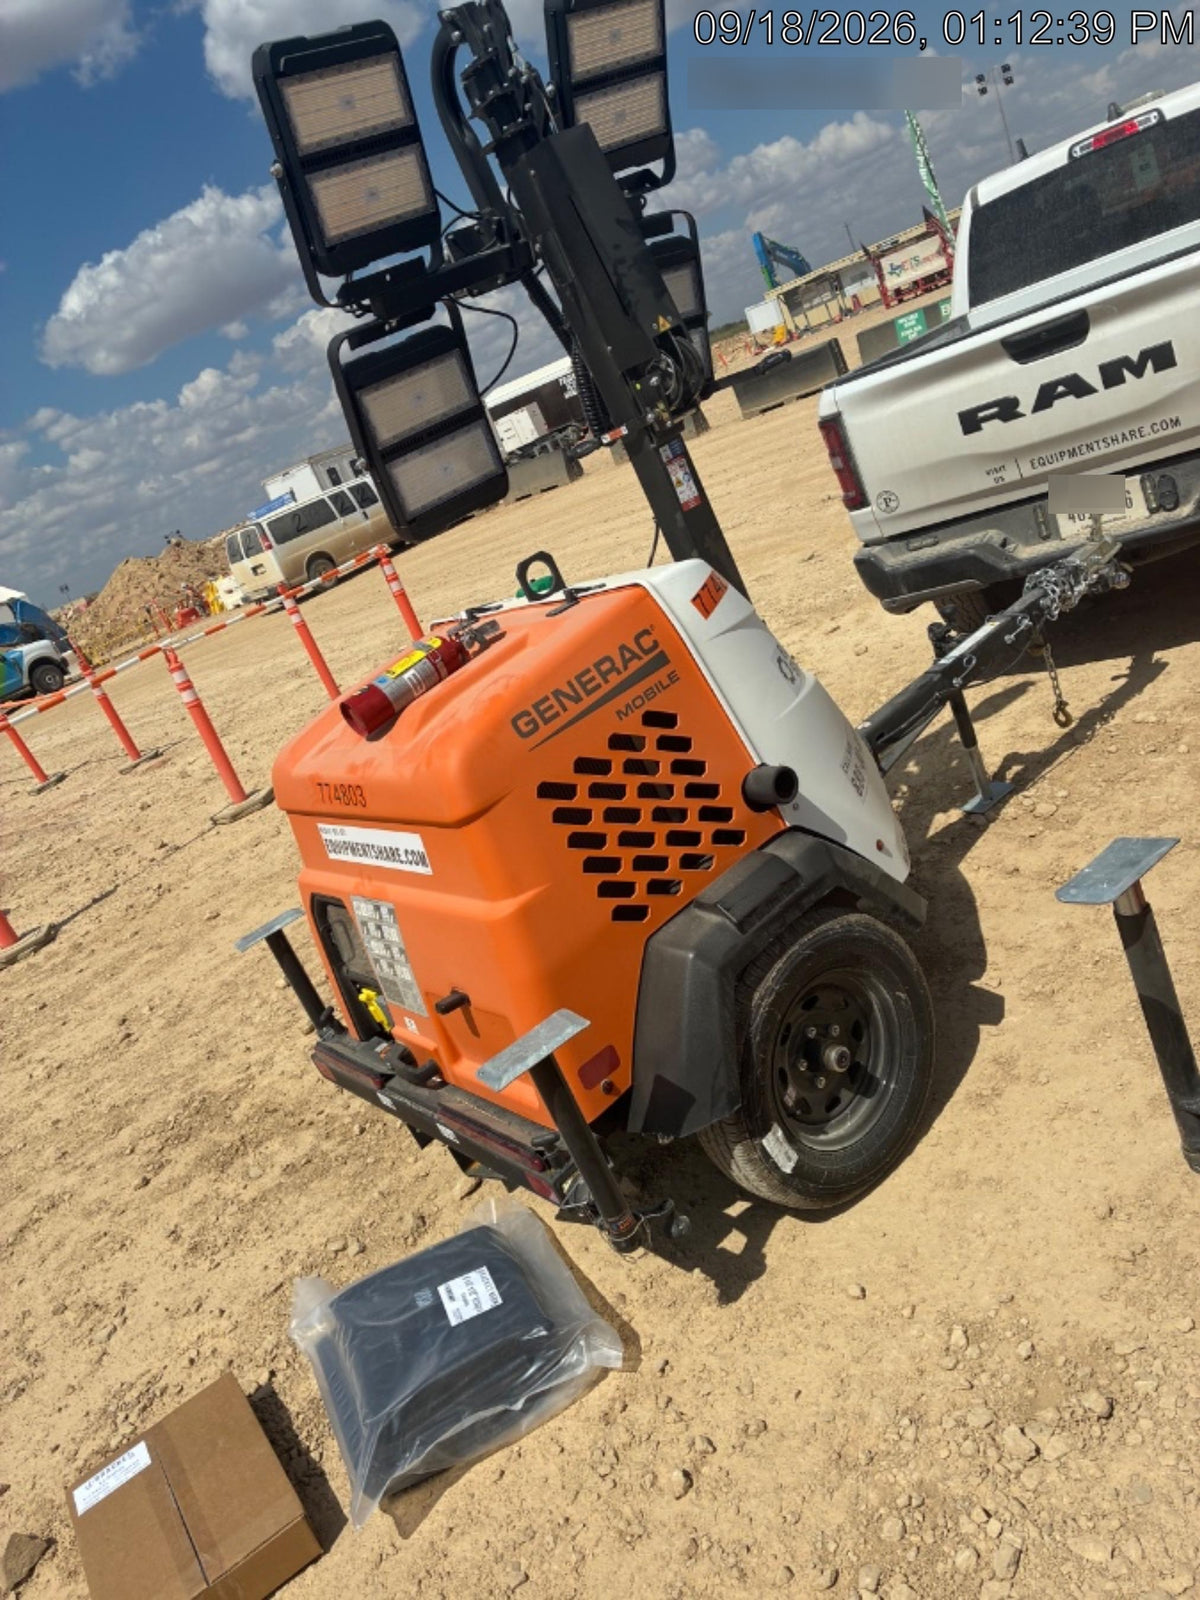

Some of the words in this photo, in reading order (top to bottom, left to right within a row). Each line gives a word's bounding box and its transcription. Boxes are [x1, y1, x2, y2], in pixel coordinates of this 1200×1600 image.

[957, 340, 1178, 436] RAM
[1029, 415, 1182, 470] EQUIPMENTSHARE.COM
[510, 629, 661, 740] GENERAC
[615, 669, 681, 721] MOBILE
[316, 782, 367, 808] 774803
[324, 838, 429, 868] EQUIPMENTSHARE.COM
